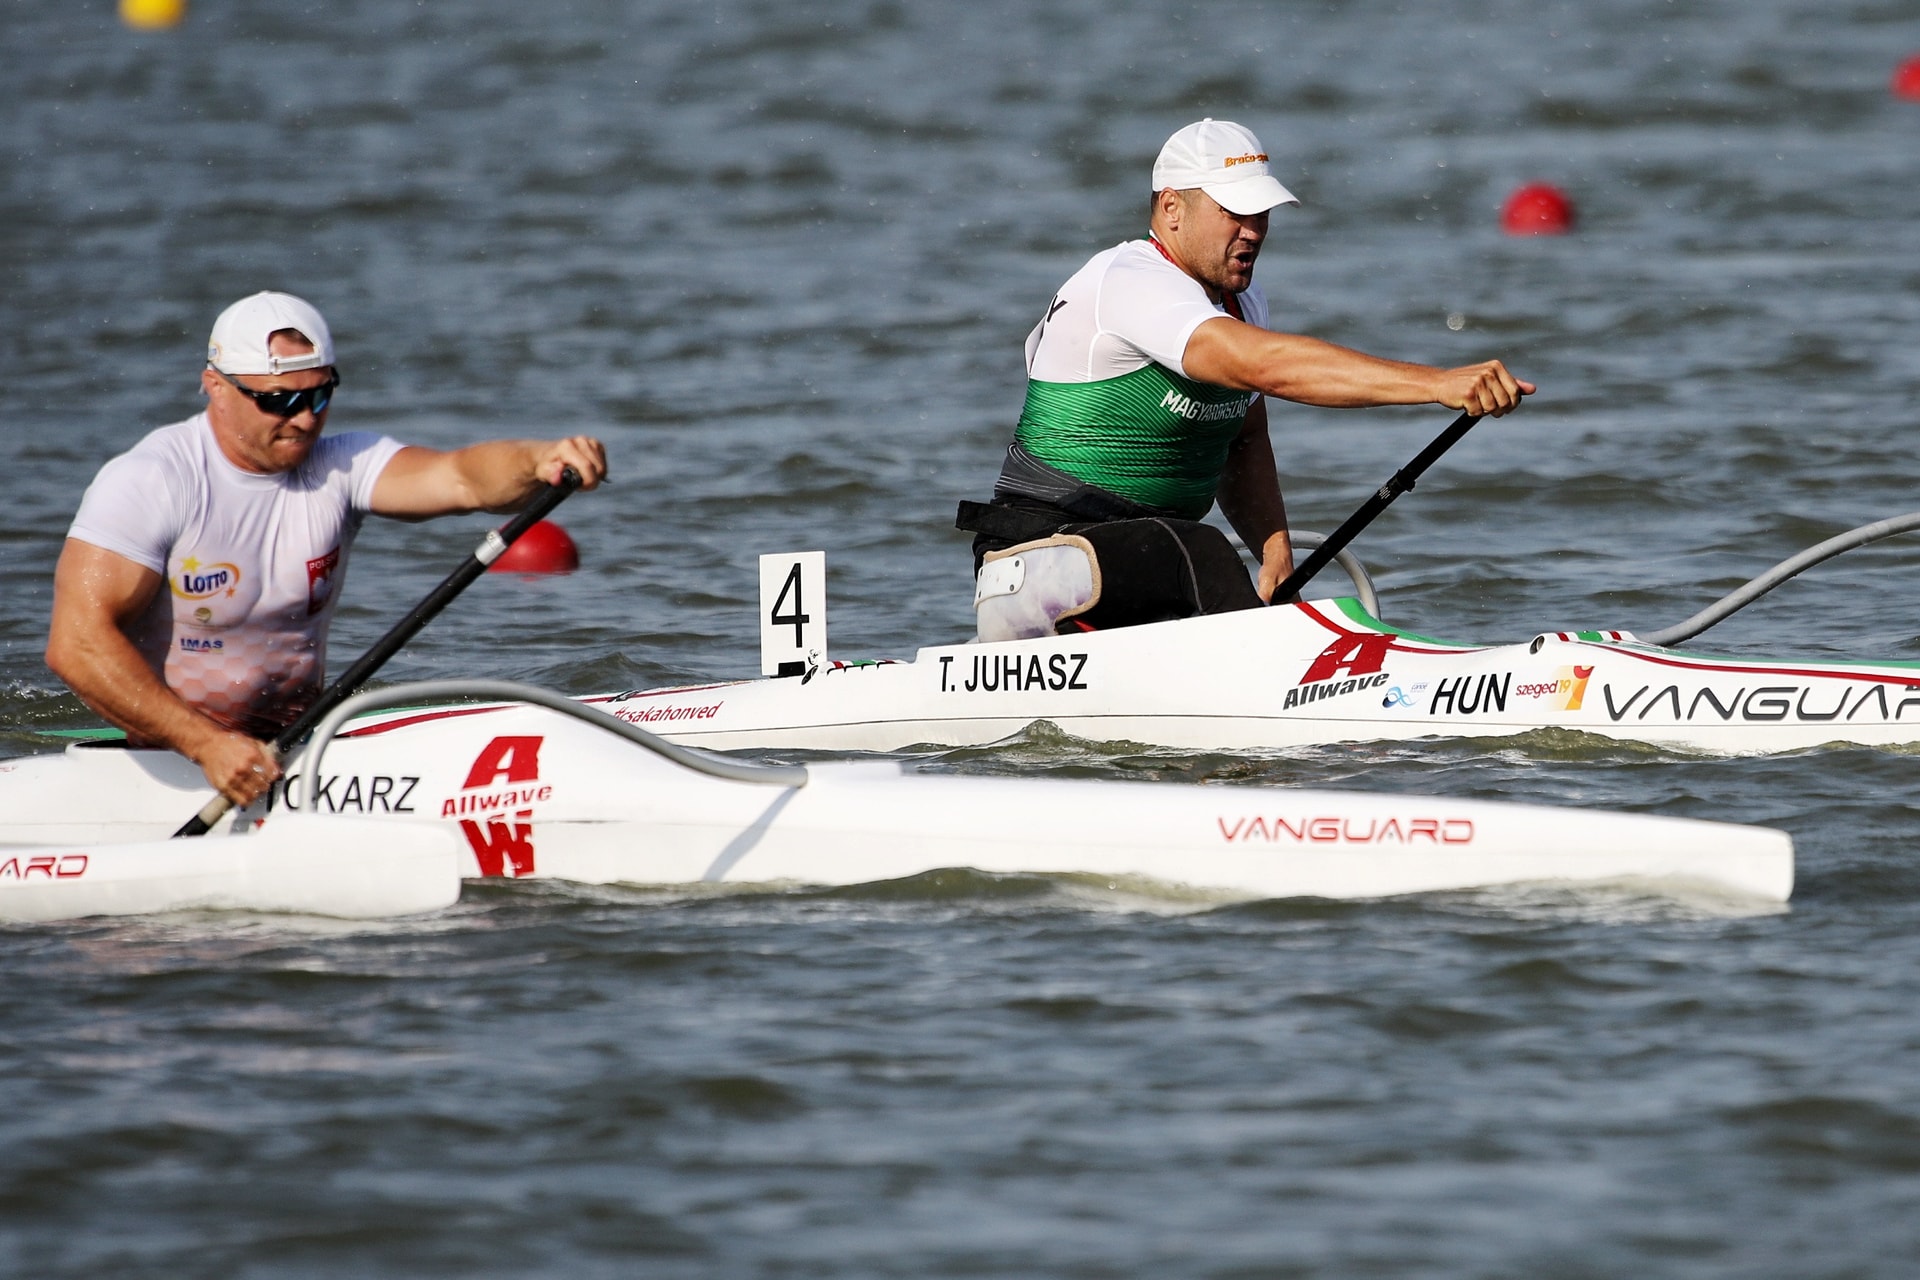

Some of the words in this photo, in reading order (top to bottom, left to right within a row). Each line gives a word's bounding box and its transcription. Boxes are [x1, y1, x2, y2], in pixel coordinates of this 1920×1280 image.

[1160, 389, 1249, 421] MAGYARORSZÁG
[184, 570, 228, 593] LOTTO
[771, 562, 810, 649] 4
[180, 637, 224, 649] IMAS
[939, 656, 956, 692] T.
[964, 653, 1088, 692] JUHASZ
[1283, 673, 1389, 710] Allwave
[1429, 672, 1513, 715] HUN
[441, 786, 553, 819] Allwave
[1218, 817, 1475, 845] VANGUARD
